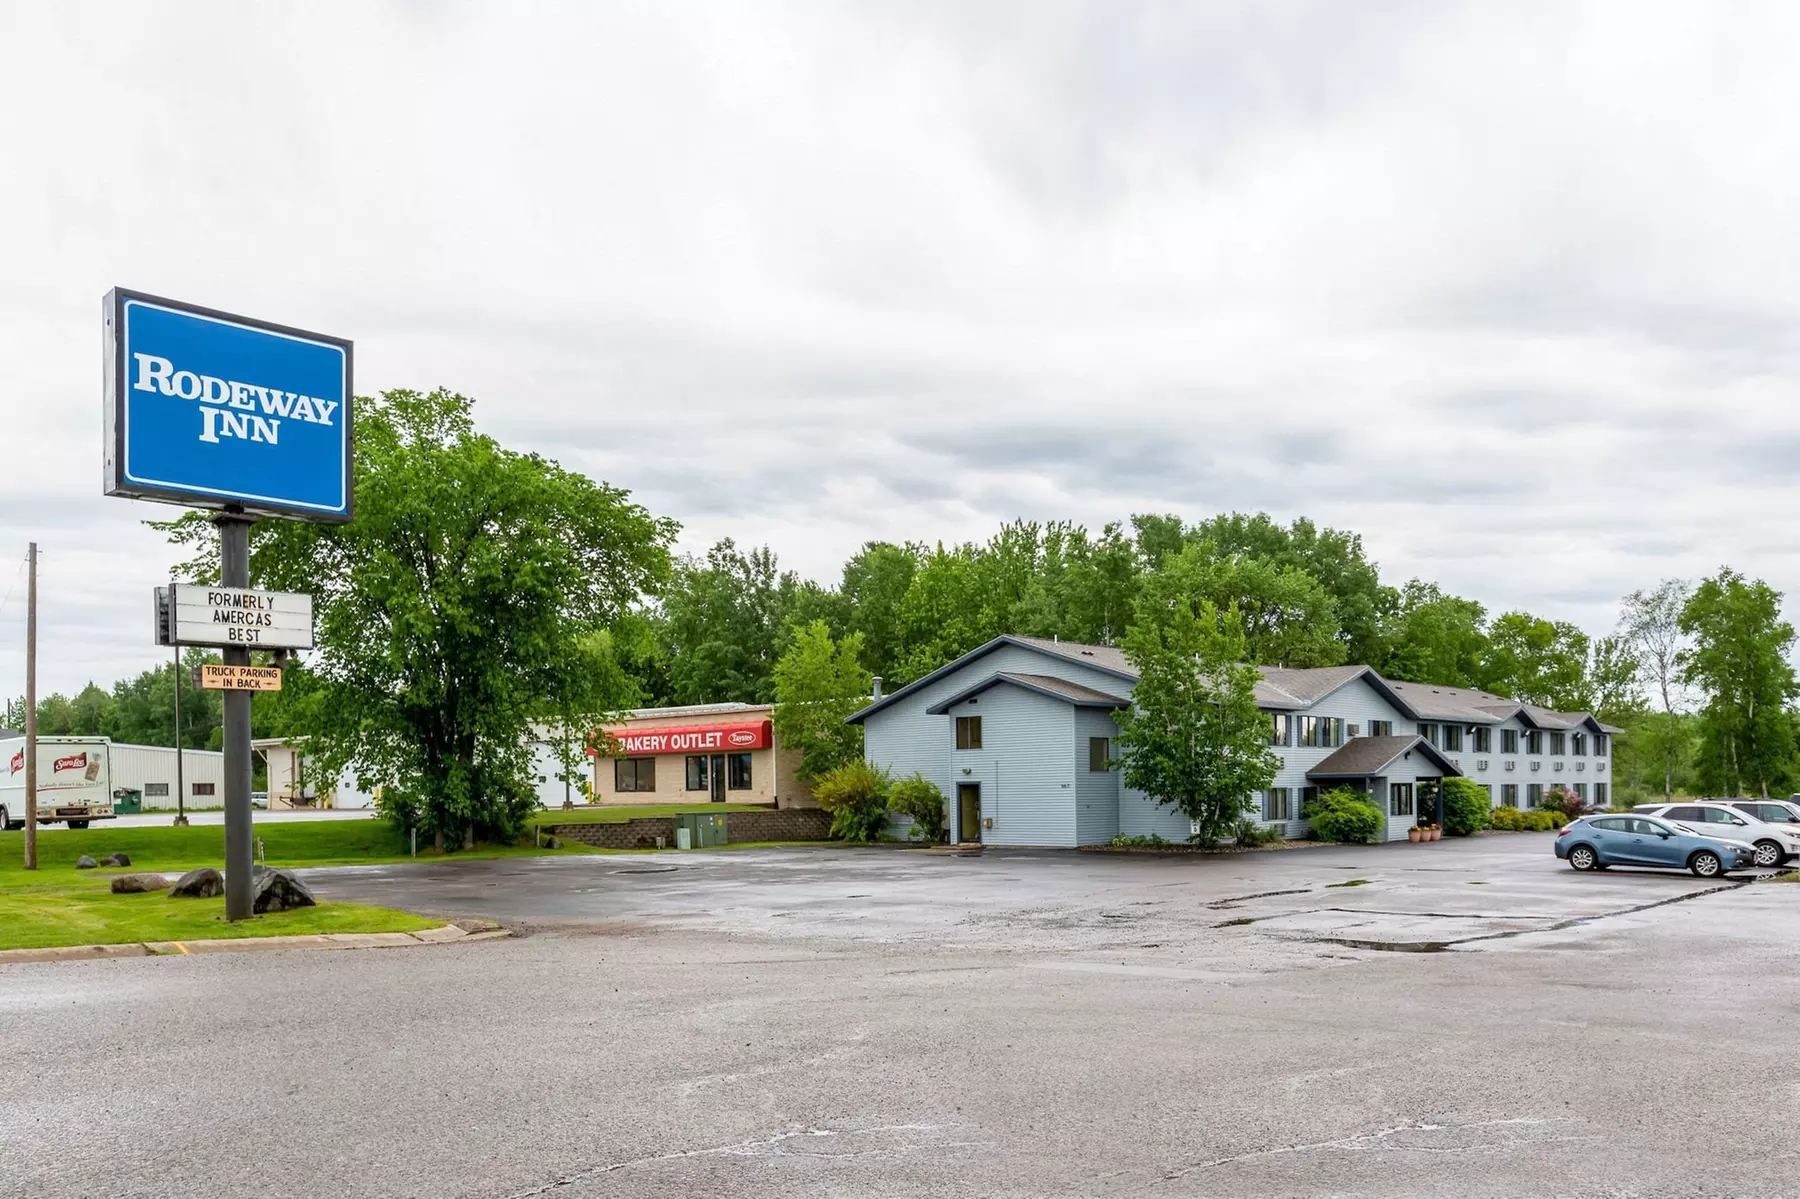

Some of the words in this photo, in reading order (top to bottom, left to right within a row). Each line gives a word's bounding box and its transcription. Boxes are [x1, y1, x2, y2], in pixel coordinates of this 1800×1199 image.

[134, 352, 338, 426] RODEWAY
[199, 405, 281, 445] INN
[208, 592, 274, 610] FORMERLY
[213, 609, 272, 626] AMERCAS
[229, 627, 260, 641] BEST
[205, 666, 236, 676] TRUCK
[240, 668, 278, 678] PARKING
[223, 678, 232, 687] IN
[237, 679, 261, 688] BACK
[671, 732, 723, 749] OUTLET
